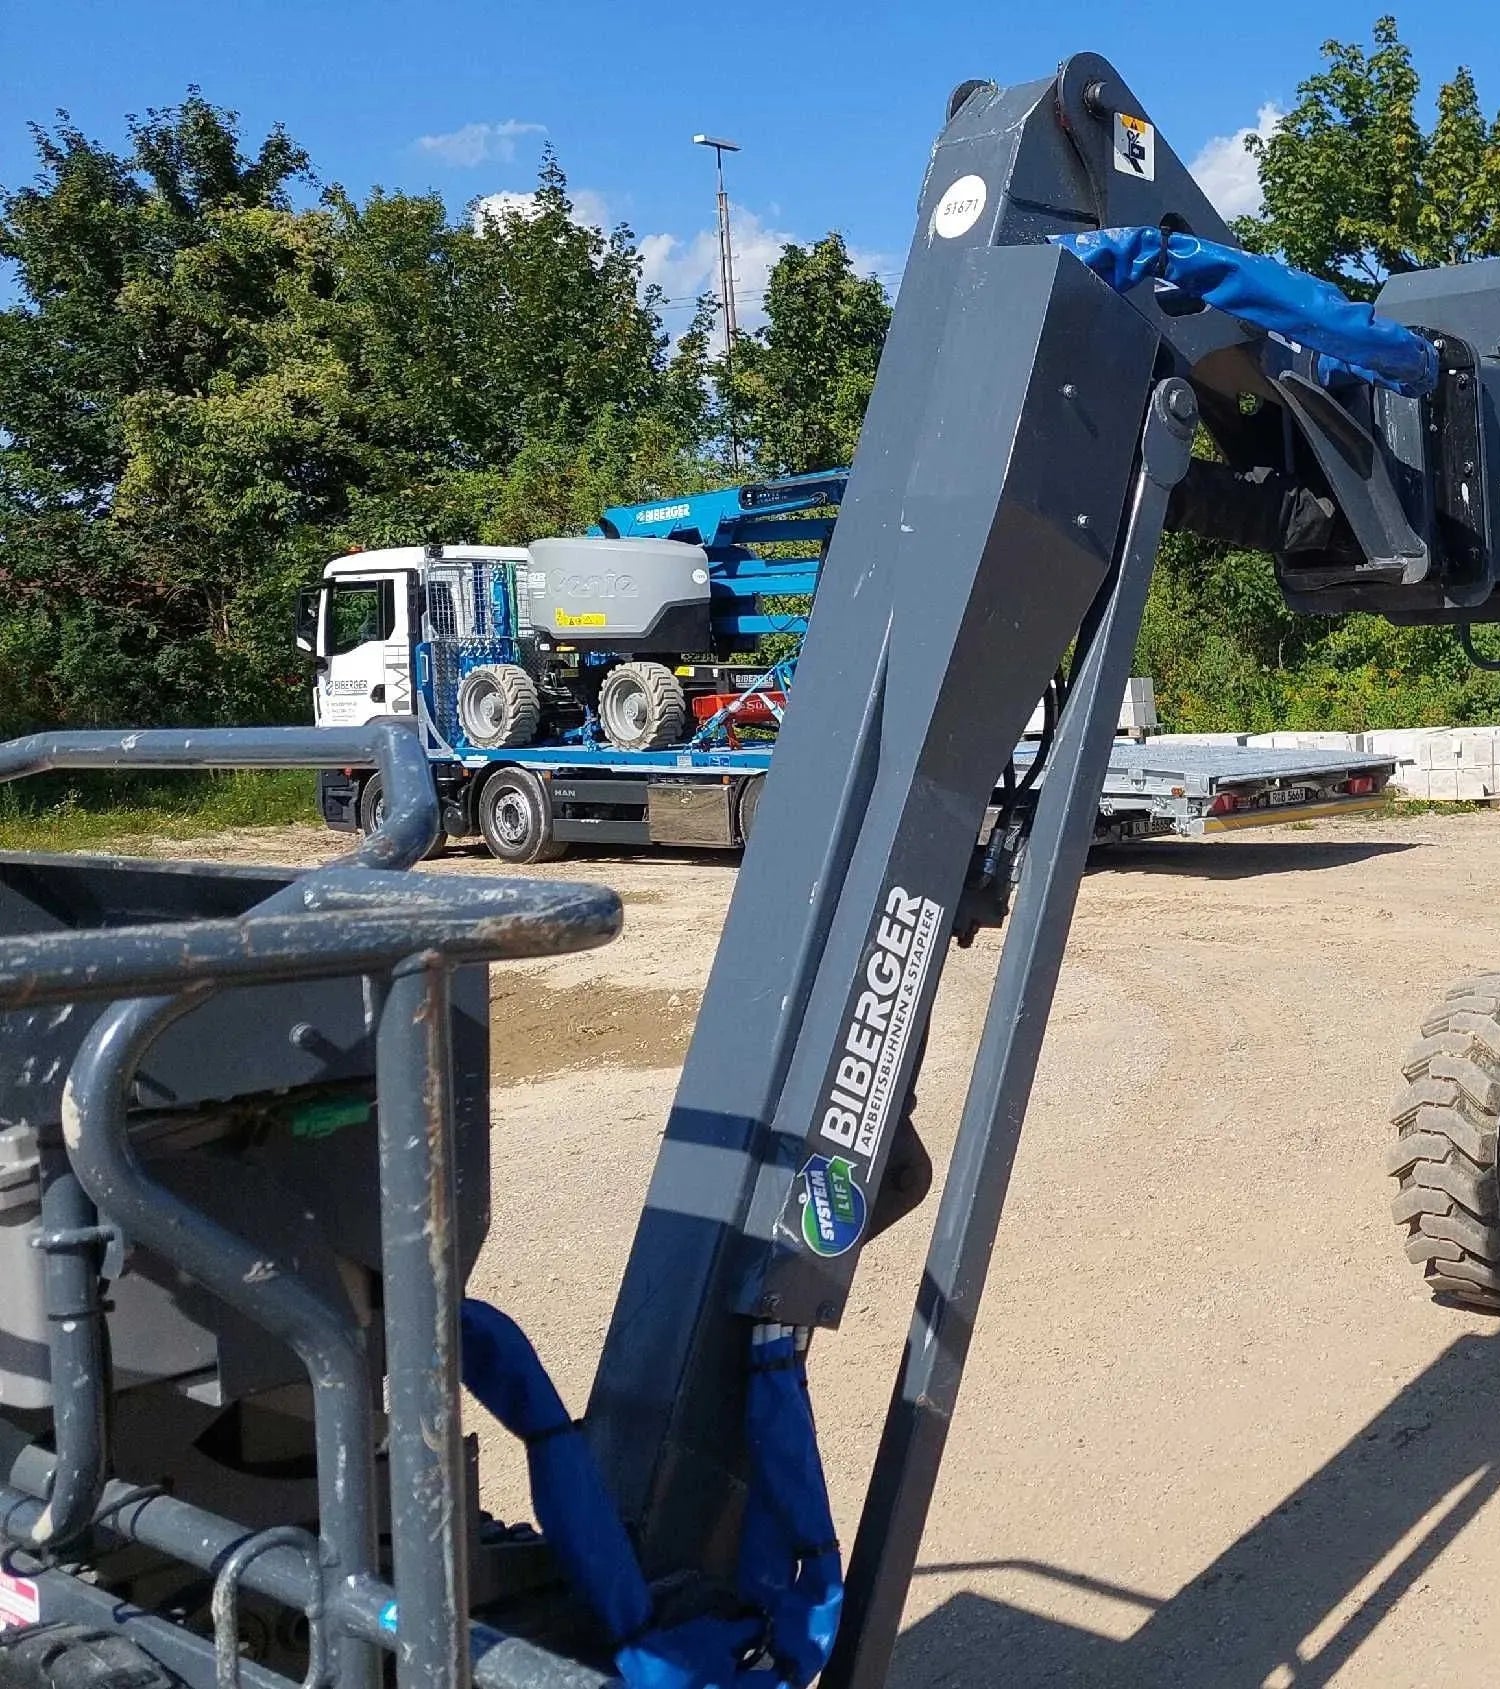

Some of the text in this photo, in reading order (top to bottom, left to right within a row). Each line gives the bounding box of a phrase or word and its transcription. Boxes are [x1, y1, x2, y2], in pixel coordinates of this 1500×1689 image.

[943, 199, 979, 216] 51671
[334, 680, 369, 690] BIBERGER
[820, 886, 923, 1150] BIBERGER
[861, 908, 936, 1148] ARBEITSBÜHNEN & STAPLER
[810, 1170, 835, 1241] SYSTEM
[832, 1172, 851, 1210] LIFT
